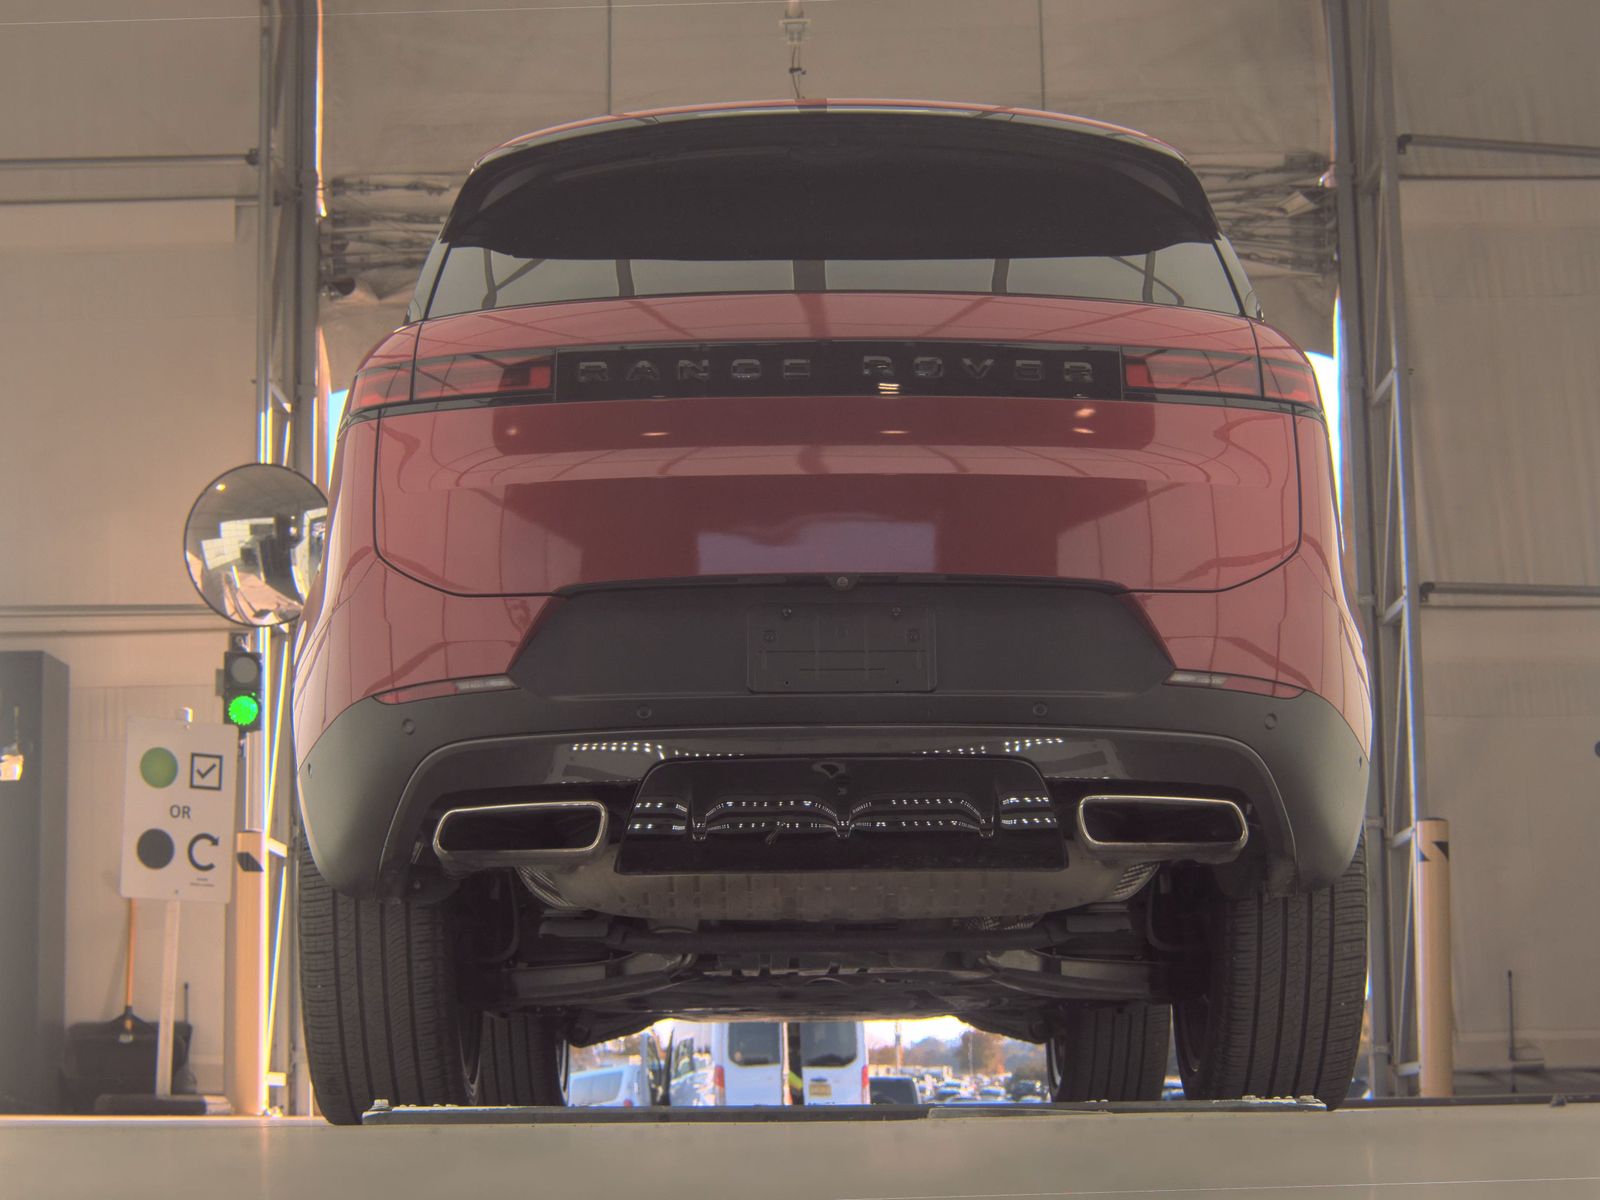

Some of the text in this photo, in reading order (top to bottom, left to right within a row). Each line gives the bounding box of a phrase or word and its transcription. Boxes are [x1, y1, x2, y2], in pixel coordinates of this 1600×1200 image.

[577, 355, 1094, 383] RANGE ROVER
[169, 804, 191, 819] OR
